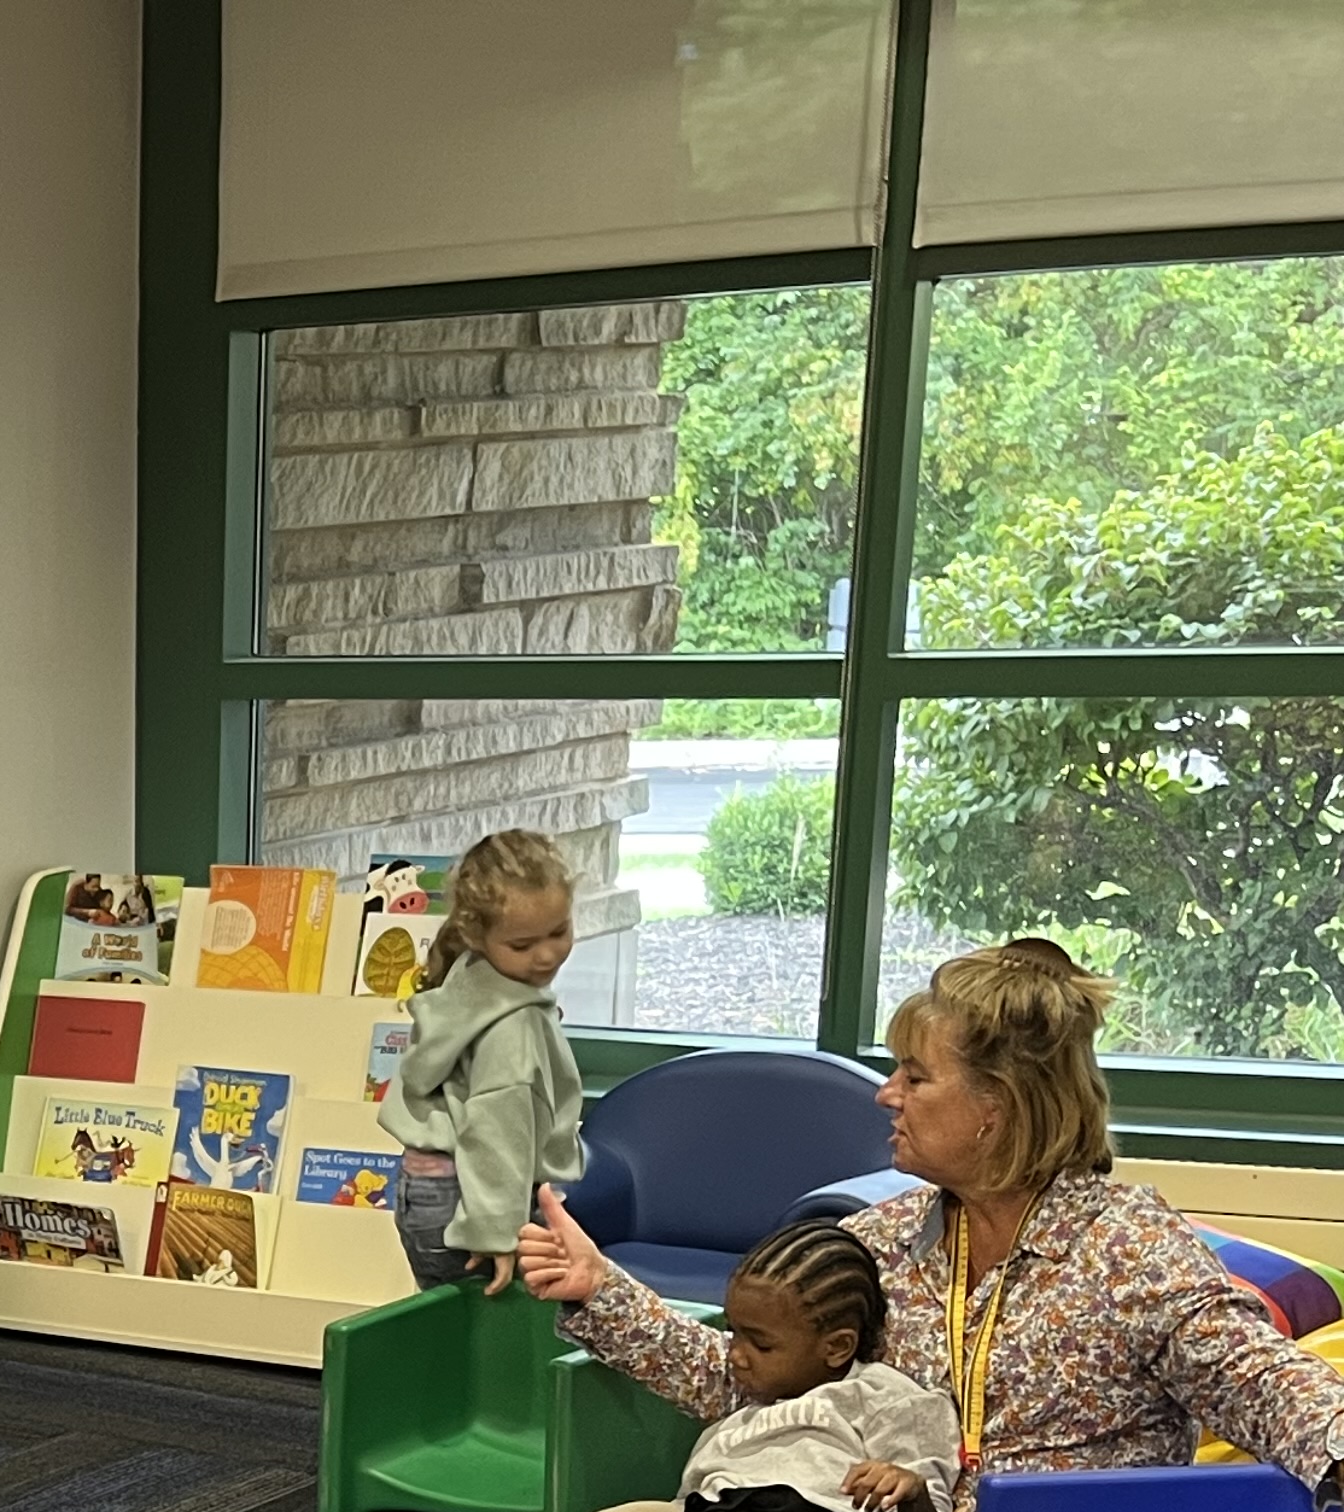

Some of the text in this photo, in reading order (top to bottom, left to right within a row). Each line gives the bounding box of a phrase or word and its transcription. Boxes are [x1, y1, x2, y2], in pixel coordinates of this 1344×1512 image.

[203, 1081, 262, 1110] DUCK
[54, 1106, 166, 1136] Little Blue Truck
[201, 1107, 256, 1138] BIKE
[304, 1164, 348, 1181] Library
[305, 1150, 396, 1169] Spot Goes to the
[172, 1190, 225, 1211] FARMER
[3, 1201, 92, 1238] Homes
